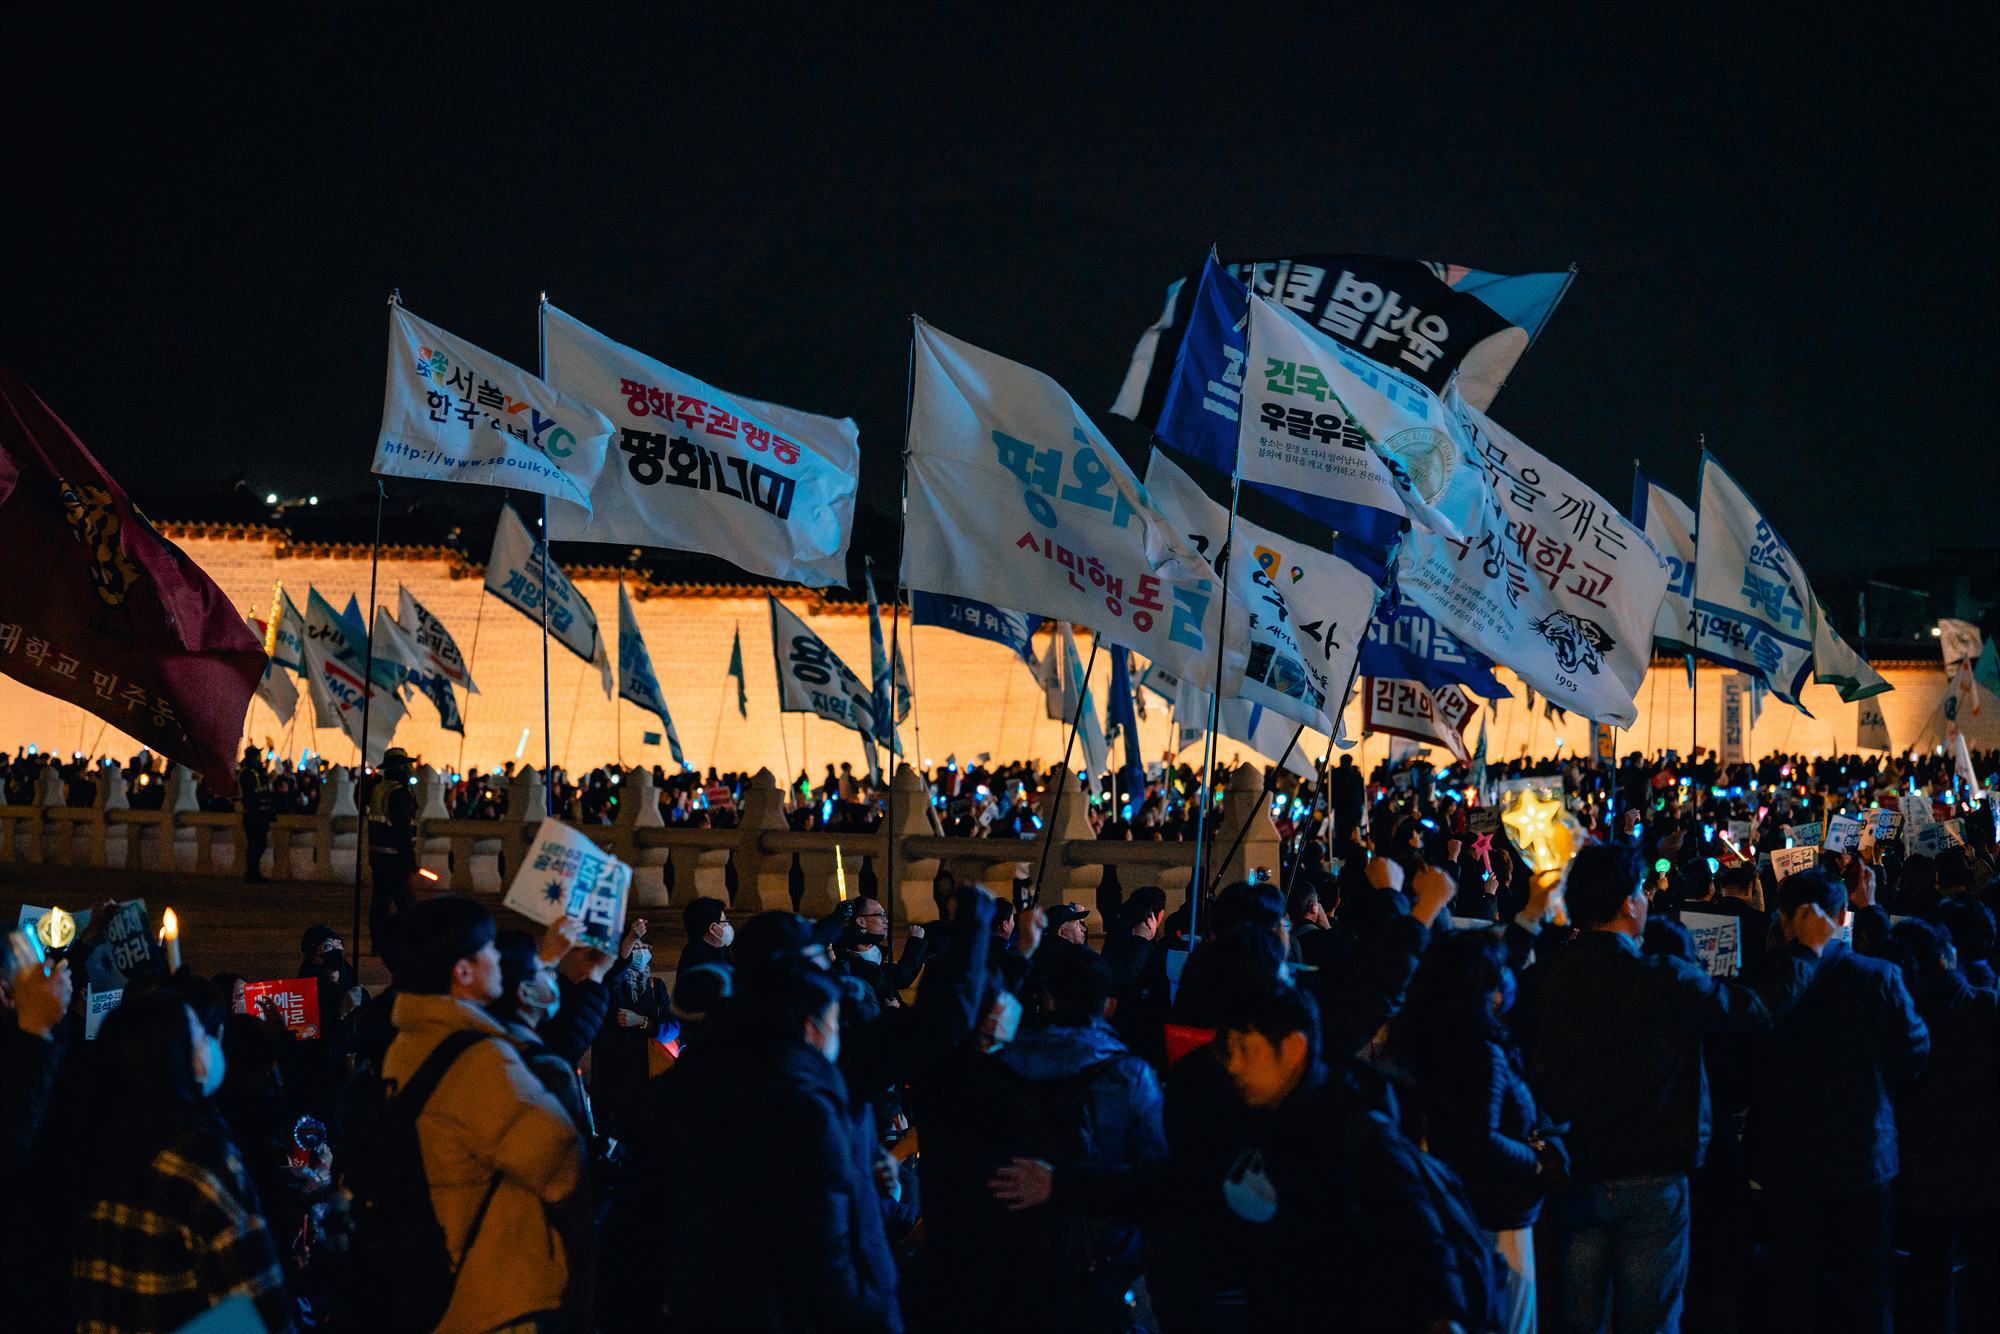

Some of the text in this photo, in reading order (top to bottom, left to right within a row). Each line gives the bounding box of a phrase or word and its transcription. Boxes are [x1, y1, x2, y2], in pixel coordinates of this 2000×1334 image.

[1263, 357, 1342, 403] 건국
[620, 378, 801, 465] 평화주권행동
[619, 427, 797, 521] 평화너머
[1311, 449, 1326, 461] 다시
[1552, 492, 1628, 560] 깨는
[1016, 531, 1165, 633] 시민행동
[92, 670, 175, 728] 민주동
[1555, 672, 1578, 692] 1905
